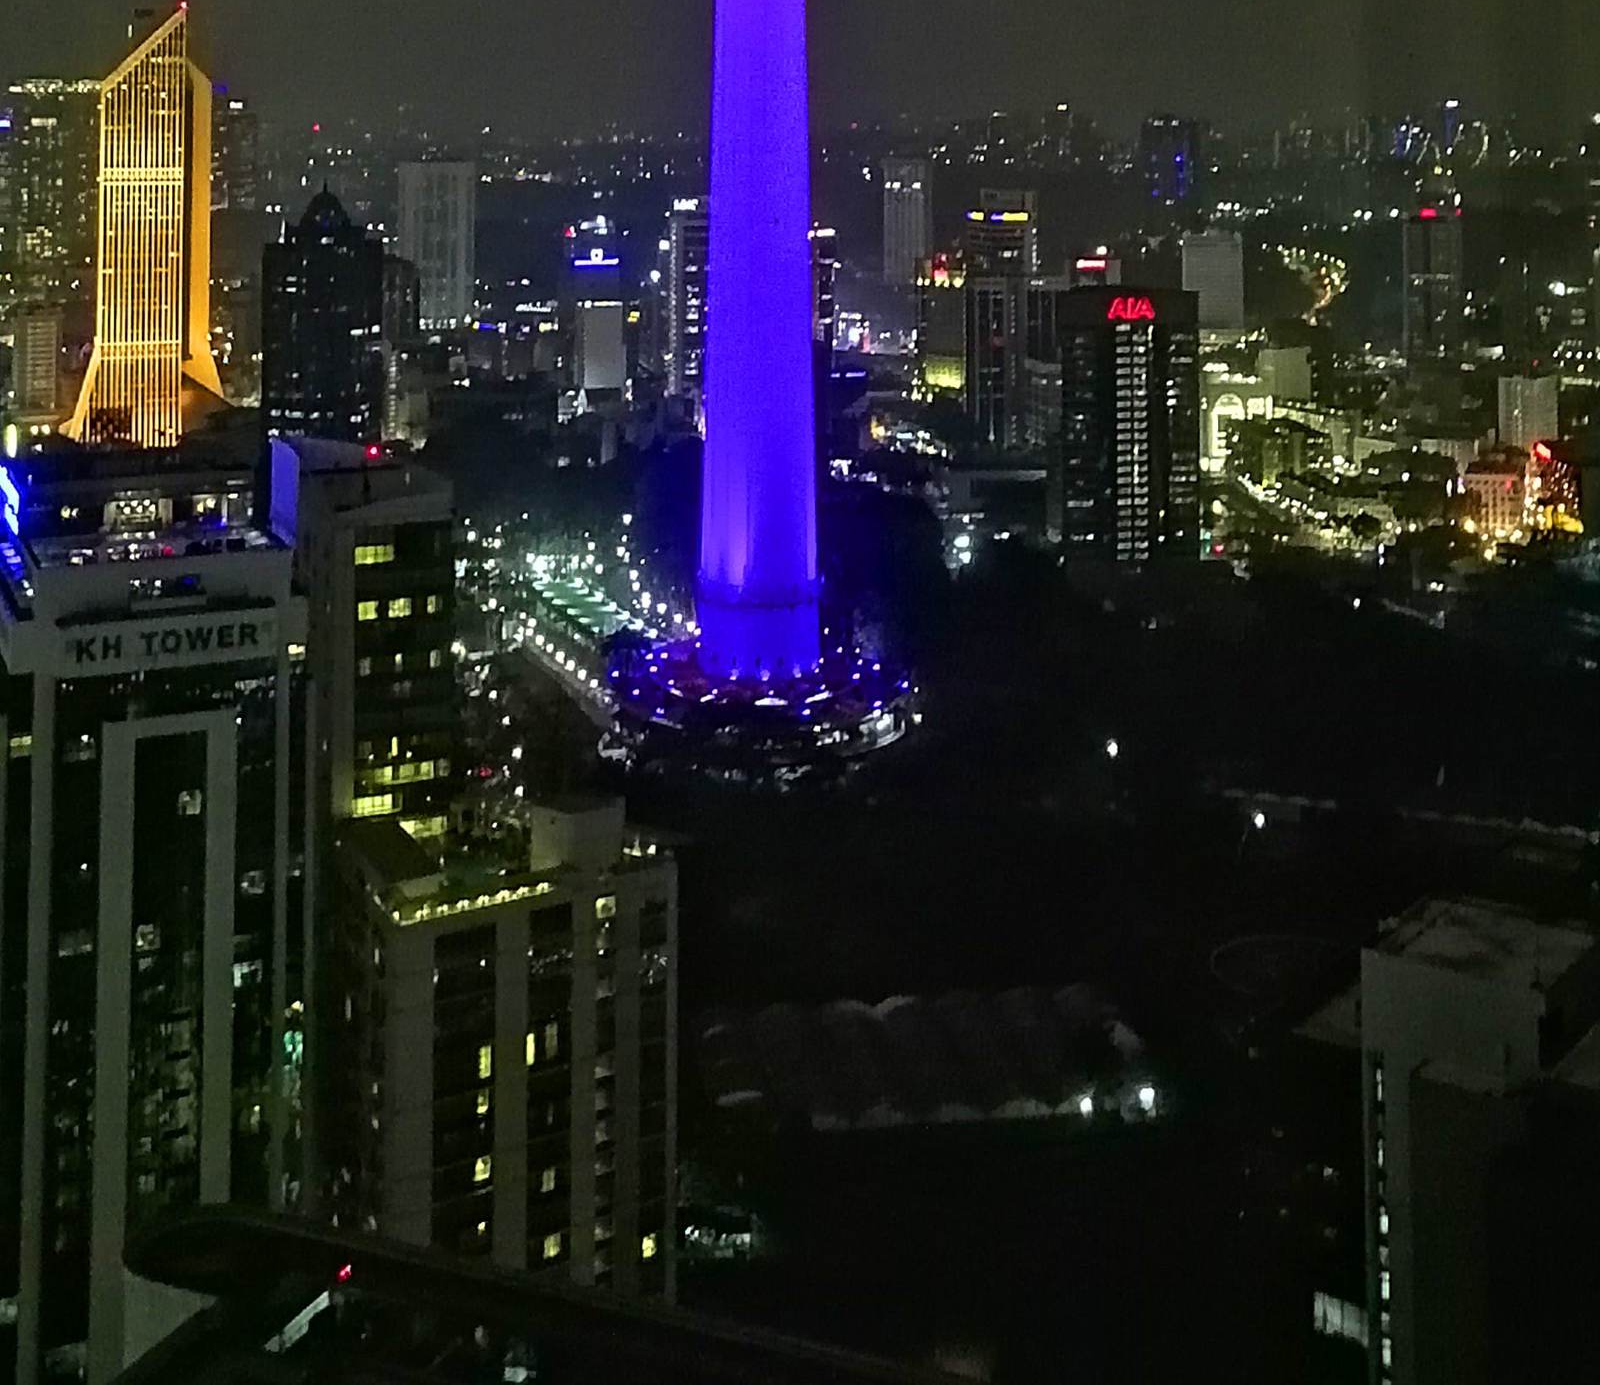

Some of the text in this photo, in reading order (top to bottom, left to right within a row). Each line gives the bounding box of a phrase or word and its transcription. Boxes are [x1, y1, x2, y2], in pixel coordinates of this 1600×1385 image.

[1107, 296, 1156, 320] AIA
[75, 623, 260, 664] KH TOWER
